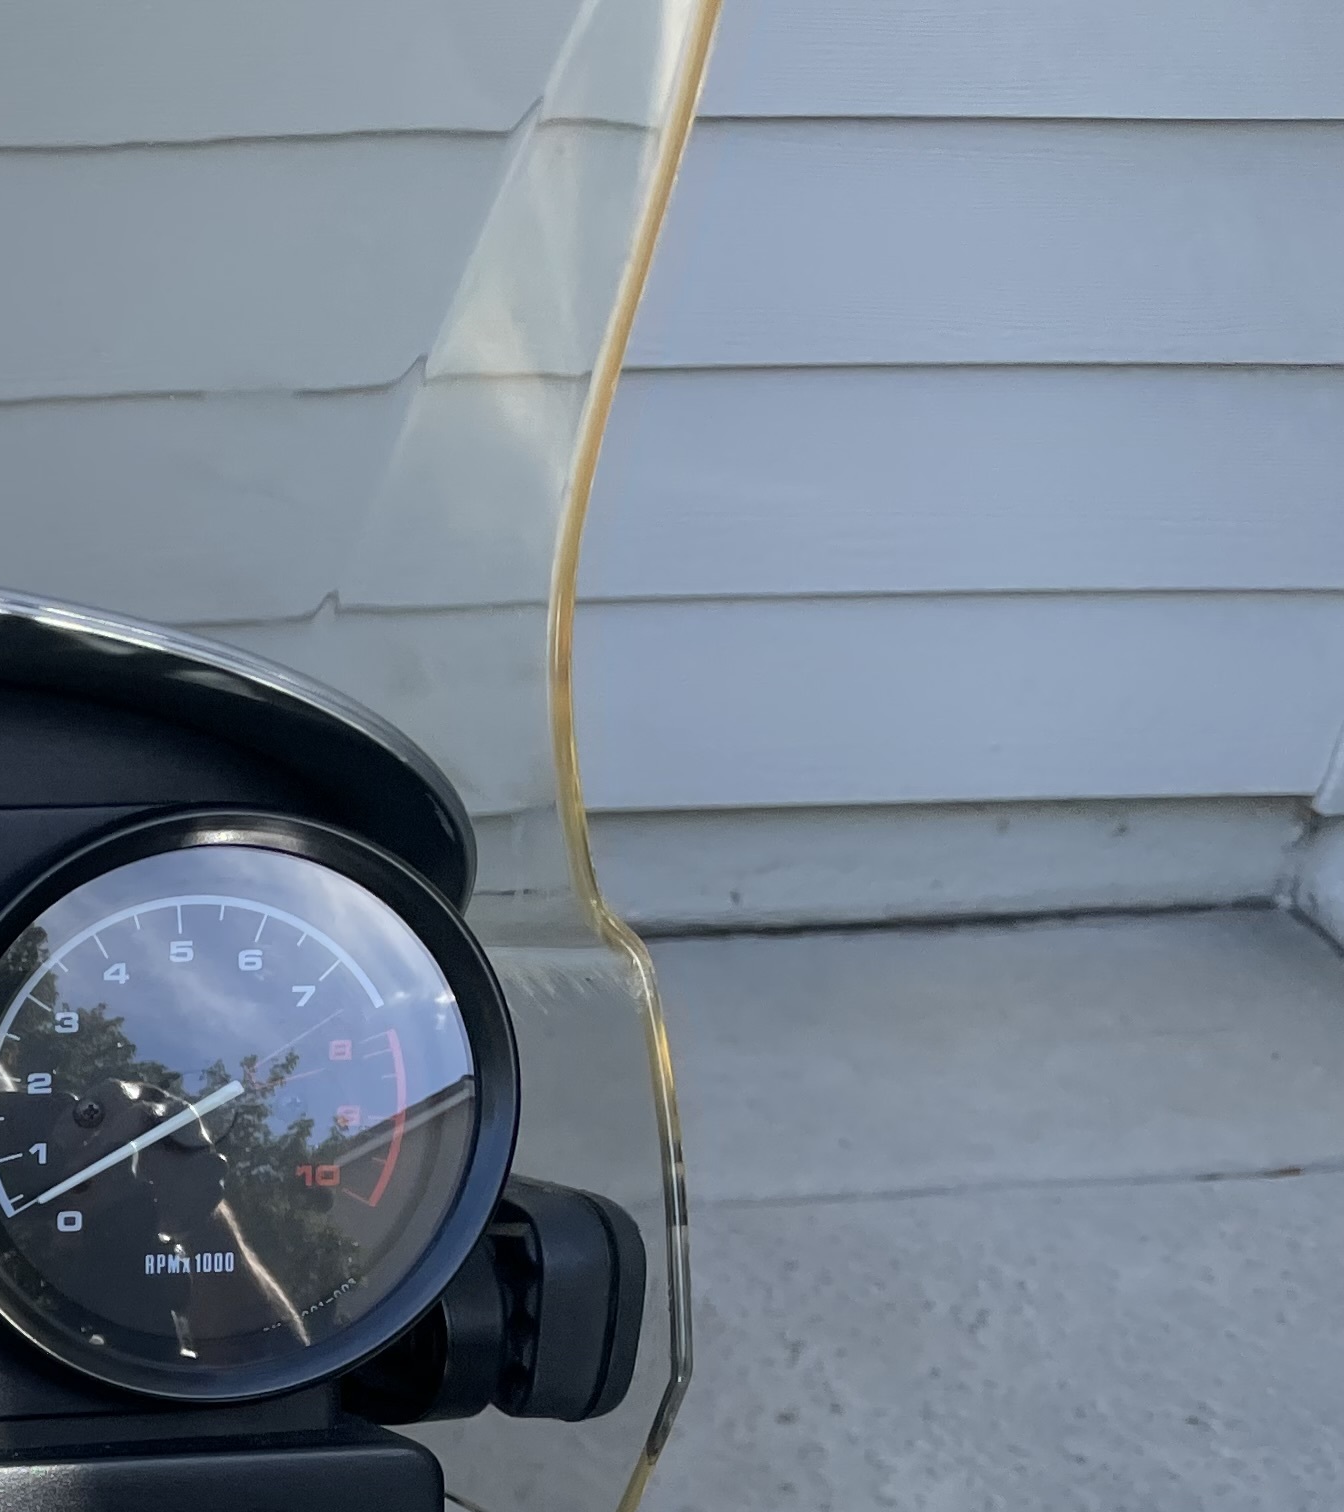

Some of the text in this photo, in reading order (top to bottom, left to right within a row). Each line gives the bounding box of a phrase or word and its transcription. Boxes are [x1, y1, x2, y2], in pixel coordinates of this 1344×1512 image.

[170, 941, 193, 962] 5
[239, 950, 262, 970] 6
[104, 963, 129, 984] 4
[292, 986, 315, 1006] 7
[55, 1012, 79, 1033] 3
[28, 1073, 51, 1094] 2
[30, 1144, 46, 1163] 1
[296, 1165, 340, 1186] 10
[57, 1211, 82, 1231] 0
